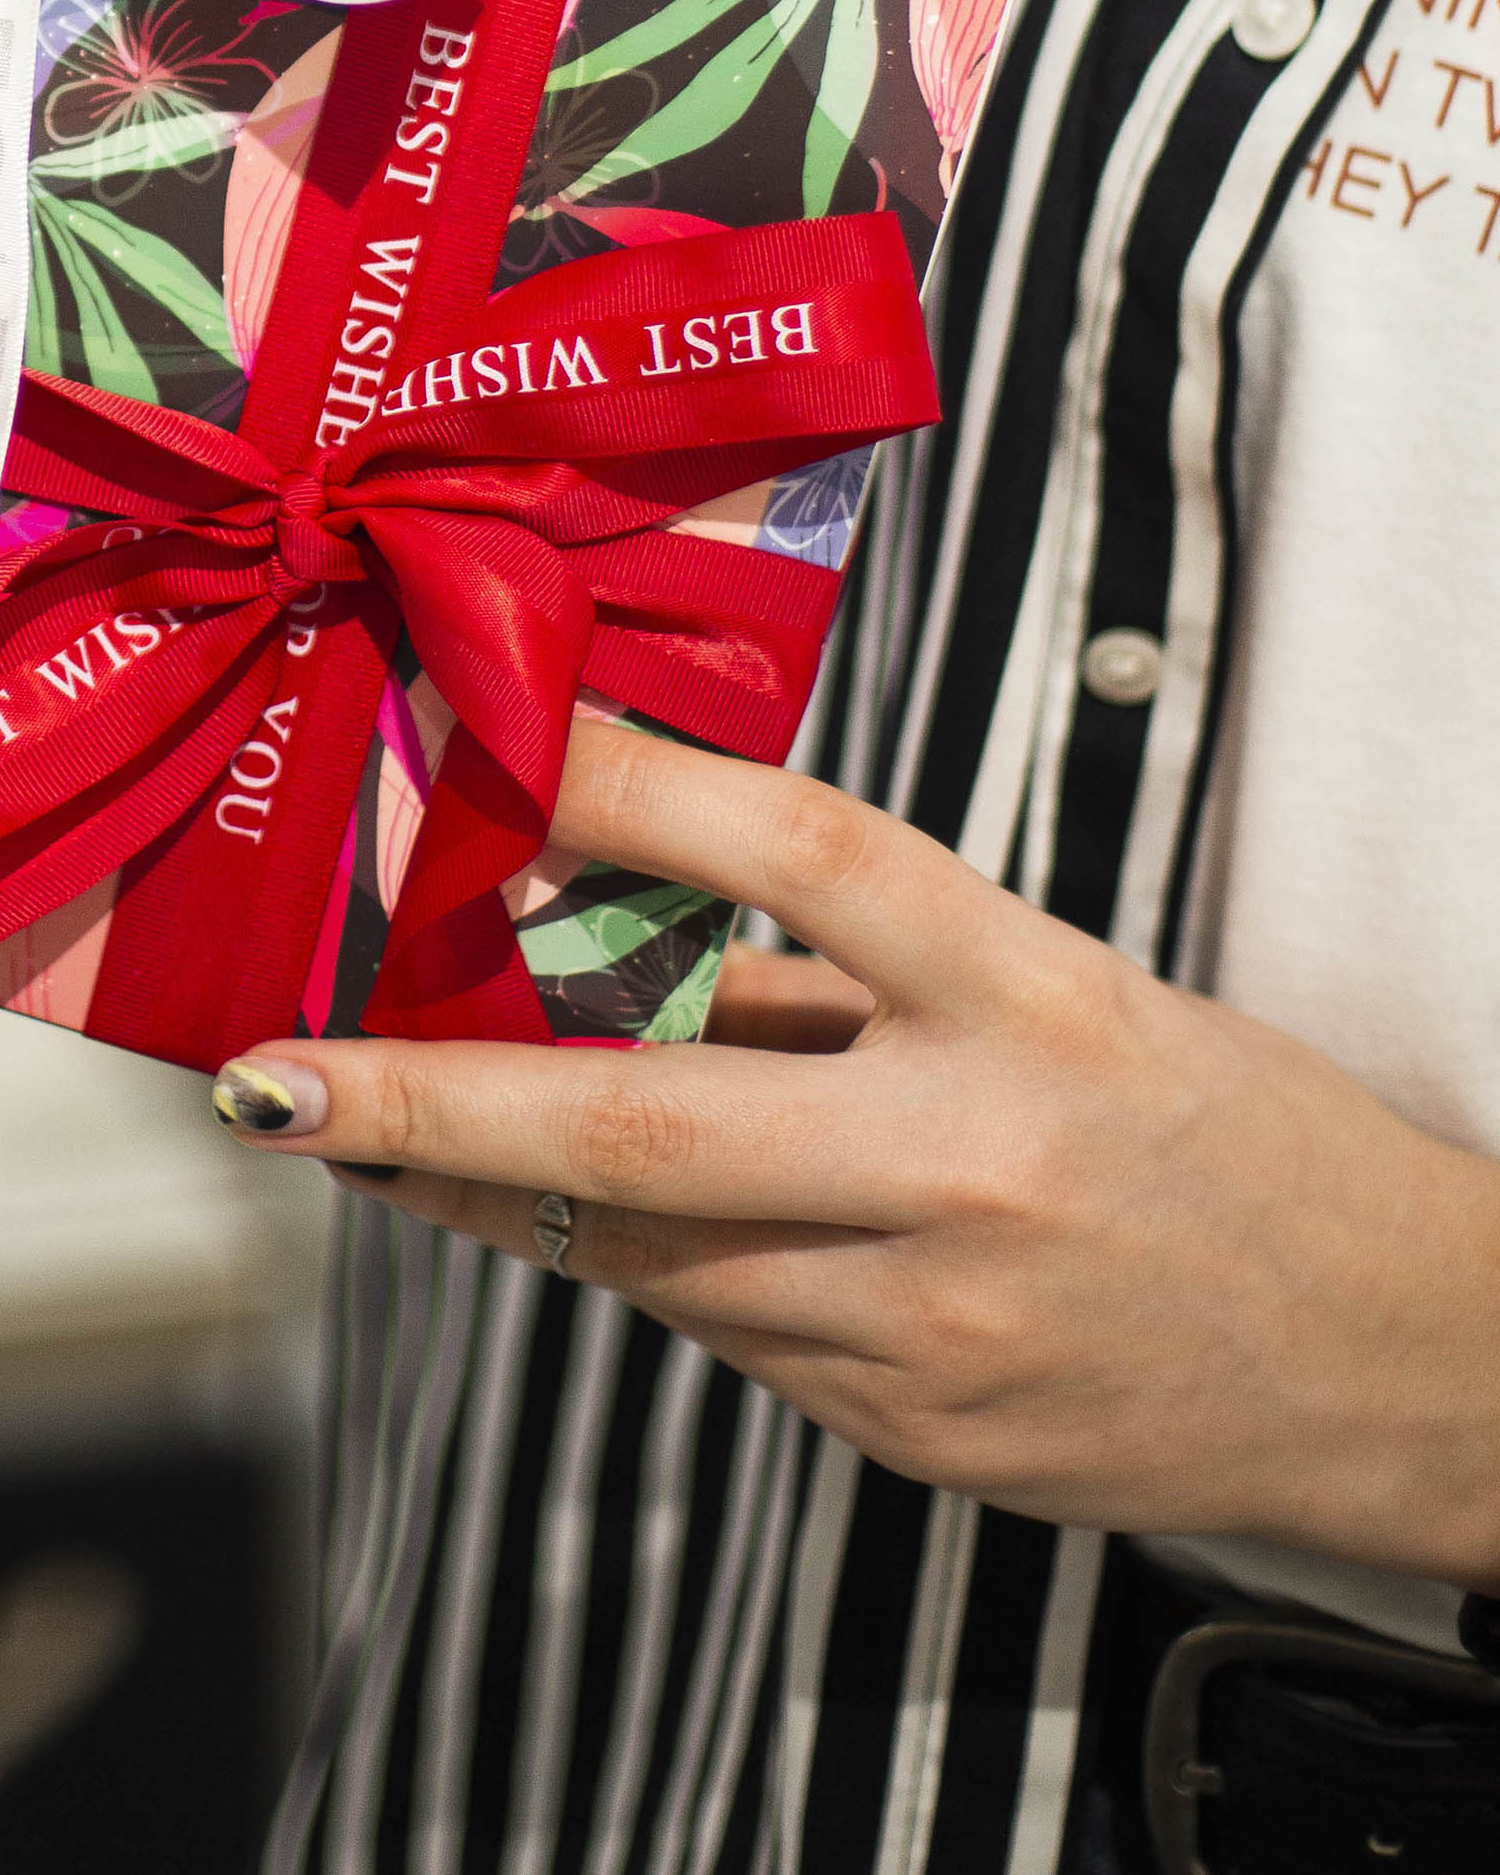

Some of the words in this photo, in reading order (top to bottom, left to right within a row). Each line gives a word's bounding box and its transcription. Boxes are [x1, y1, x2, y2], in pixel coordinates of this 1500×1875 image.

[383, 19, 476, 205] BEST
[1306, 139, 1451, 229] HEY
[314, 234, 422, 449] WISHE
[640, 300, 819, 380] BEST
